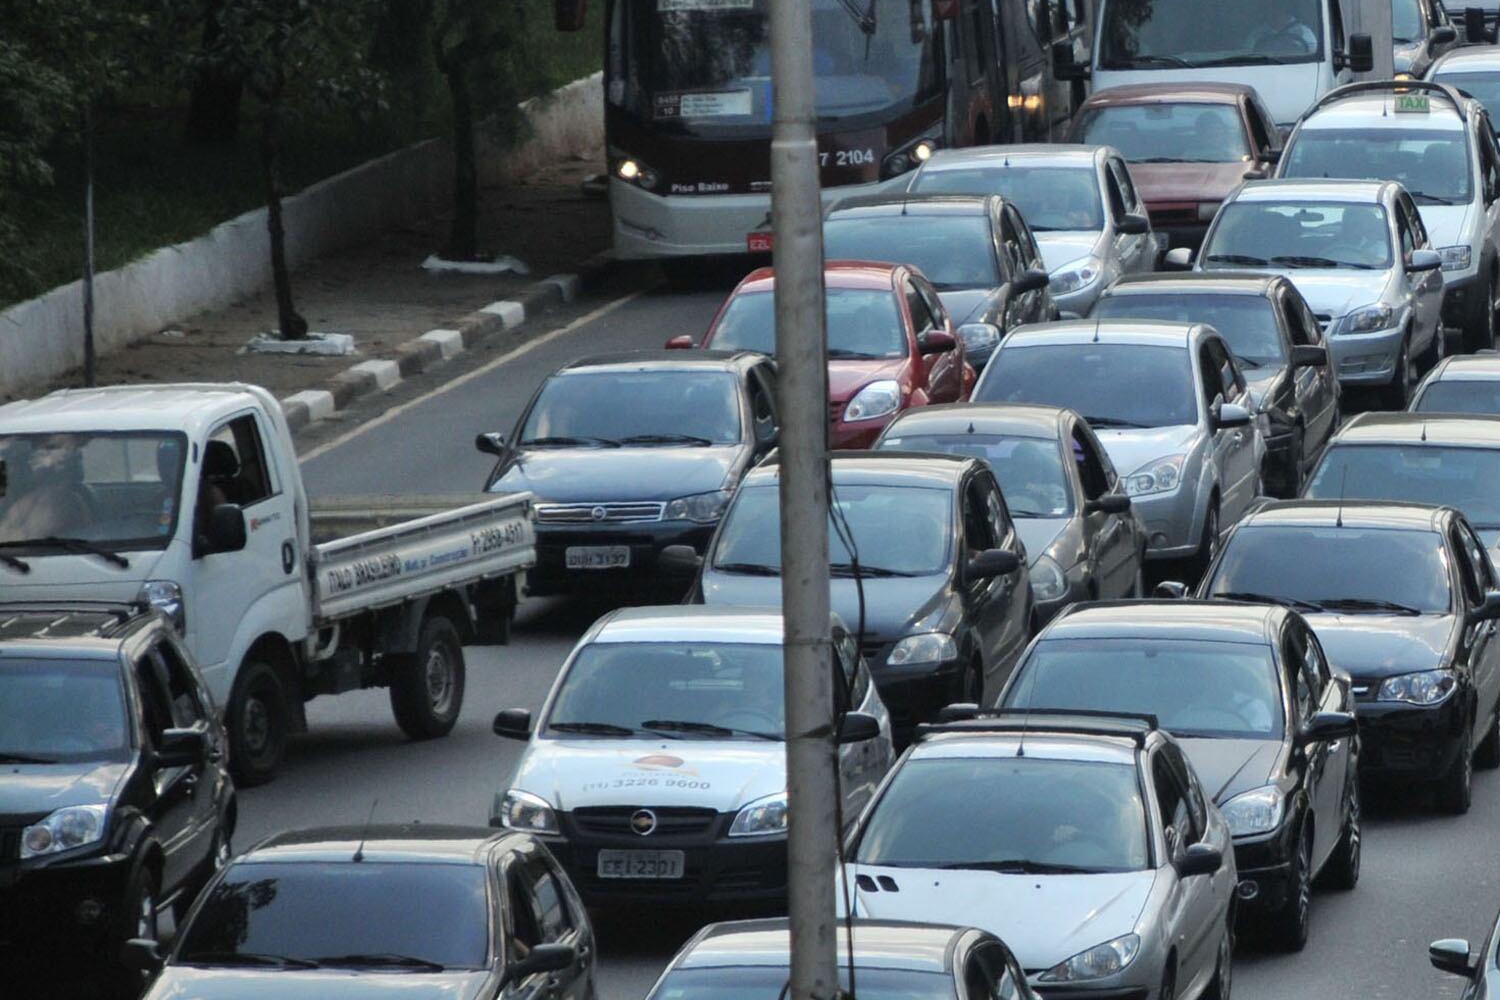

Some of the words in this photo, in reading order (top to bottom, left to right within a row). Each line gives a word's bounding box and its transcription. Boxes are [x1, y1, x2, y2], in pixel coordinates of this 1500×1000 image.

[1397, 96, 1428, 110] TAXI
[836, 149, 874, 166] 2104
[672, 183, 695, 193] Piso
[698, 181, 729, 192] Baixo
